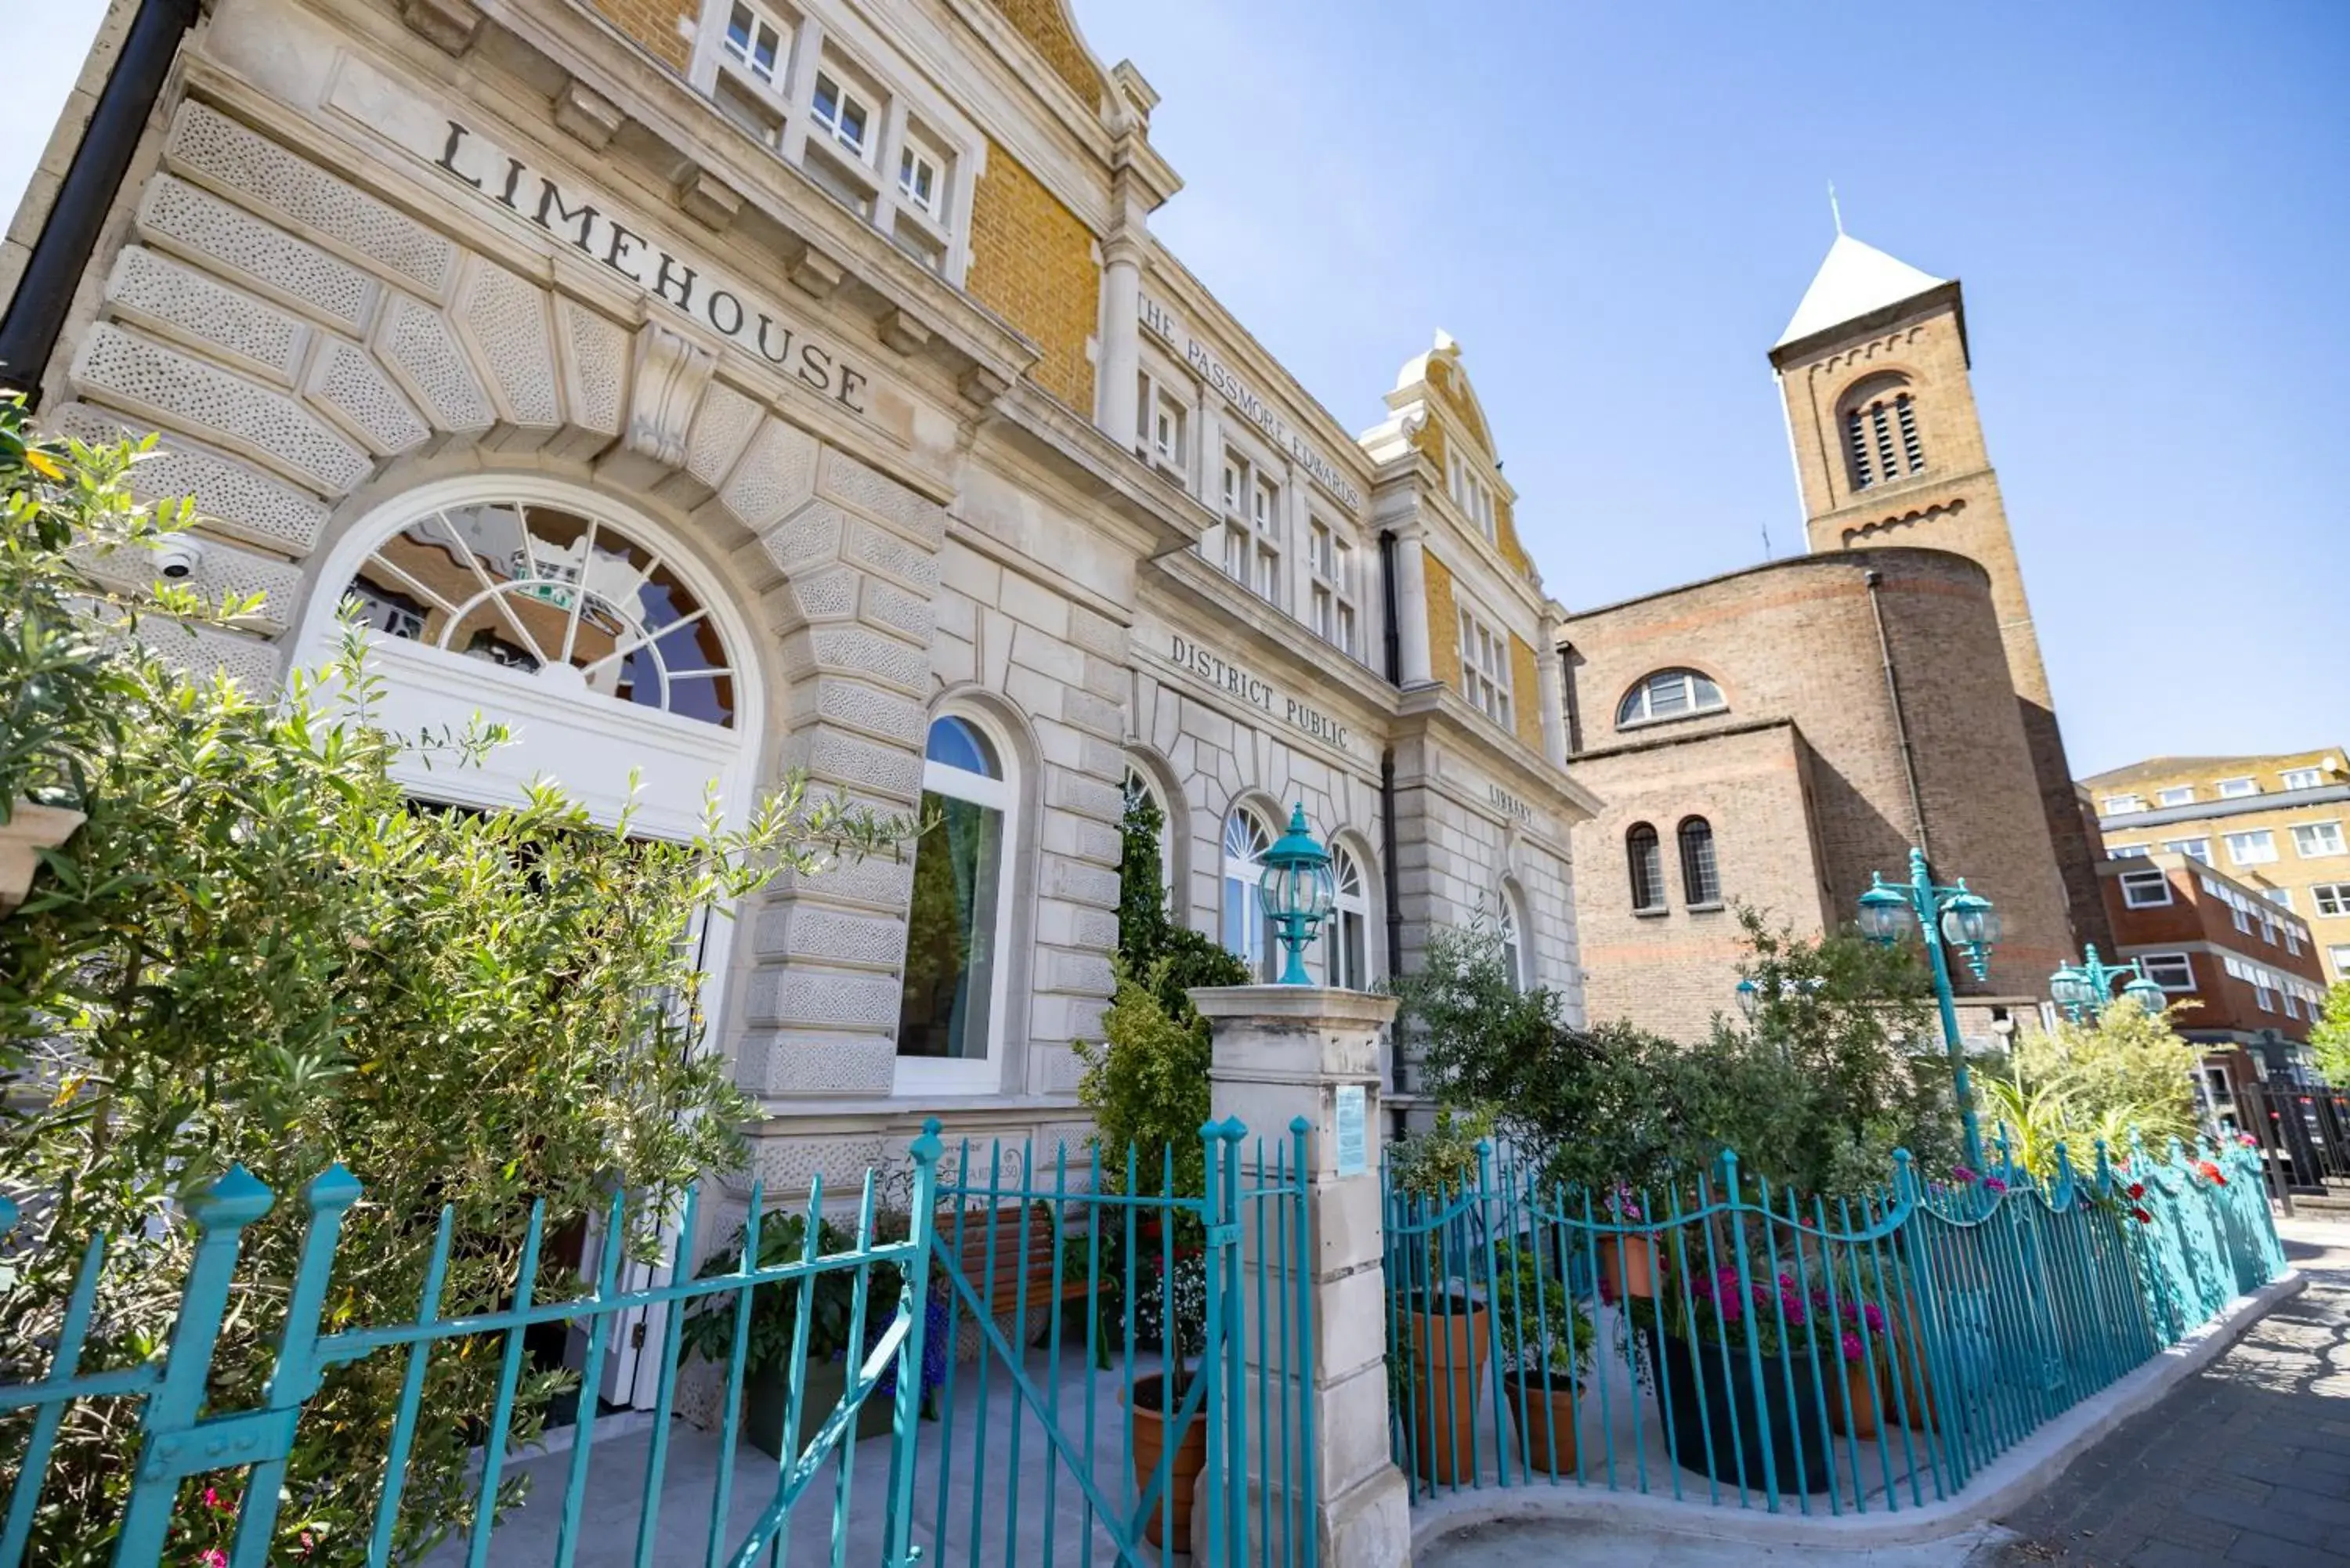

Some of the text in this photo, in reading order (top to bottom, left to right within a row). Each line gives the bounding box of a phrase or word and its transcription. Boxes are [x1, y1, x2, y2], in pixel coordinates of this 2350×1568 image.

[436, 120, 869, 414] LIMEHOUSE
[1188, 338, 1286, 445] PASSMORE
[1293, 436, 1358, 509] EDWARDS
[1173, 634, 1347, 749] DISTRICT PUBLIC
[1489, 784, 1533, 827] LIBRARY
